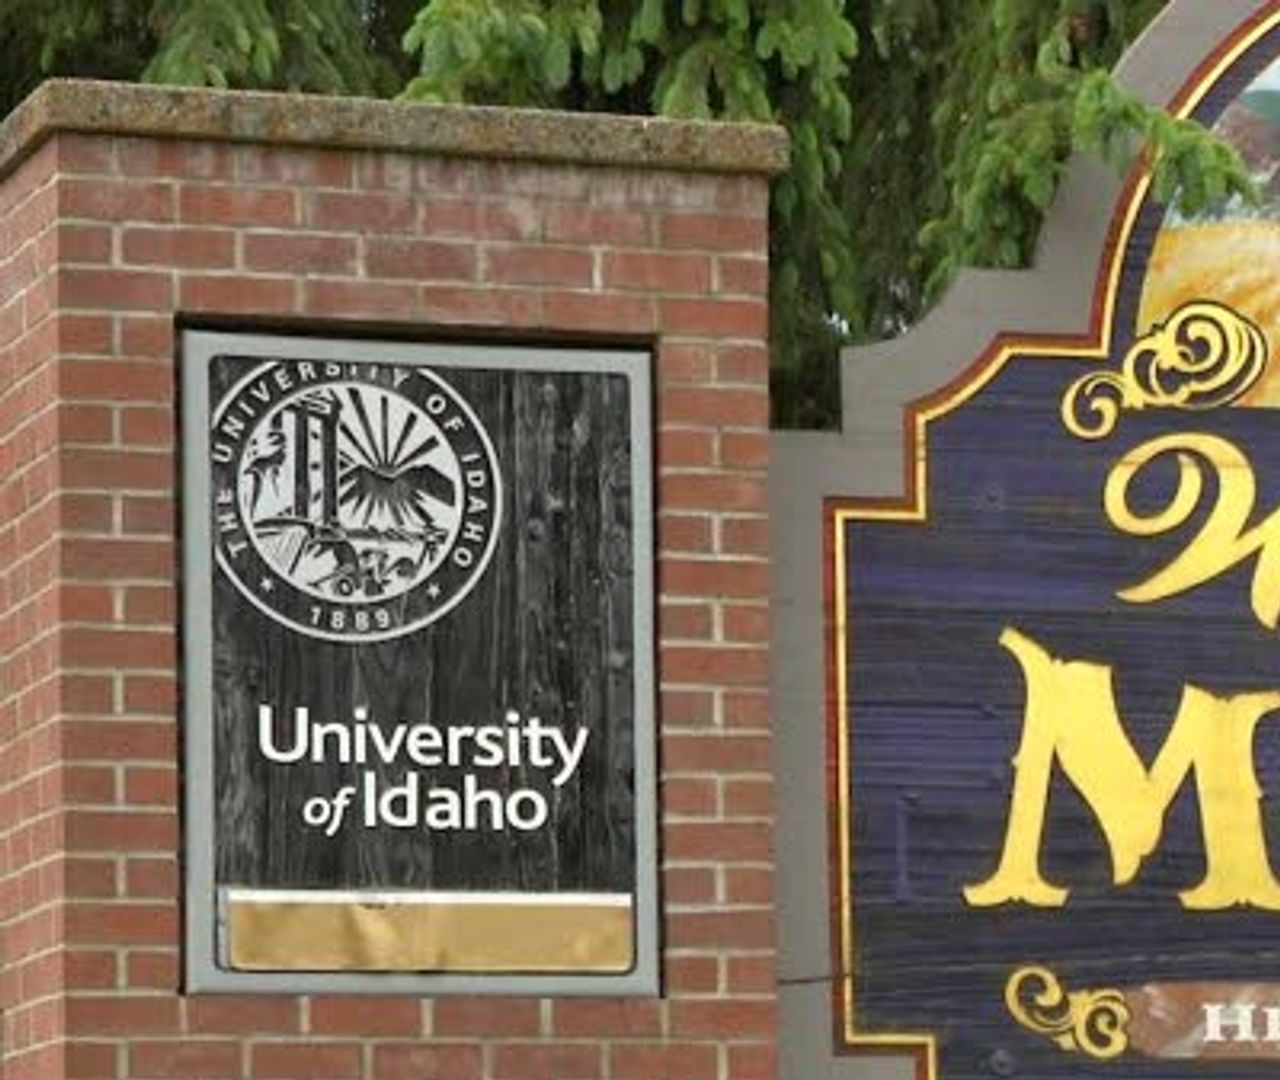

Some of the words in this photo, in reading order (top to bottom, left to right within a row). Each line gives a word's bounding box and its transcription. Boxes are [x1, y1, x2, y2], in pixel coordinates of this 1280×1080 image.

[217, 488, 248, 559] THE
[425, 393, 465, 433] OF
[452, 452, 489, 568] IDAHO
[310, 607, 390, 629] 1889
[257, 703, 590, 786] University
[302, 786, 356, 836] of
[363, 771, 550, 832] Idaho
